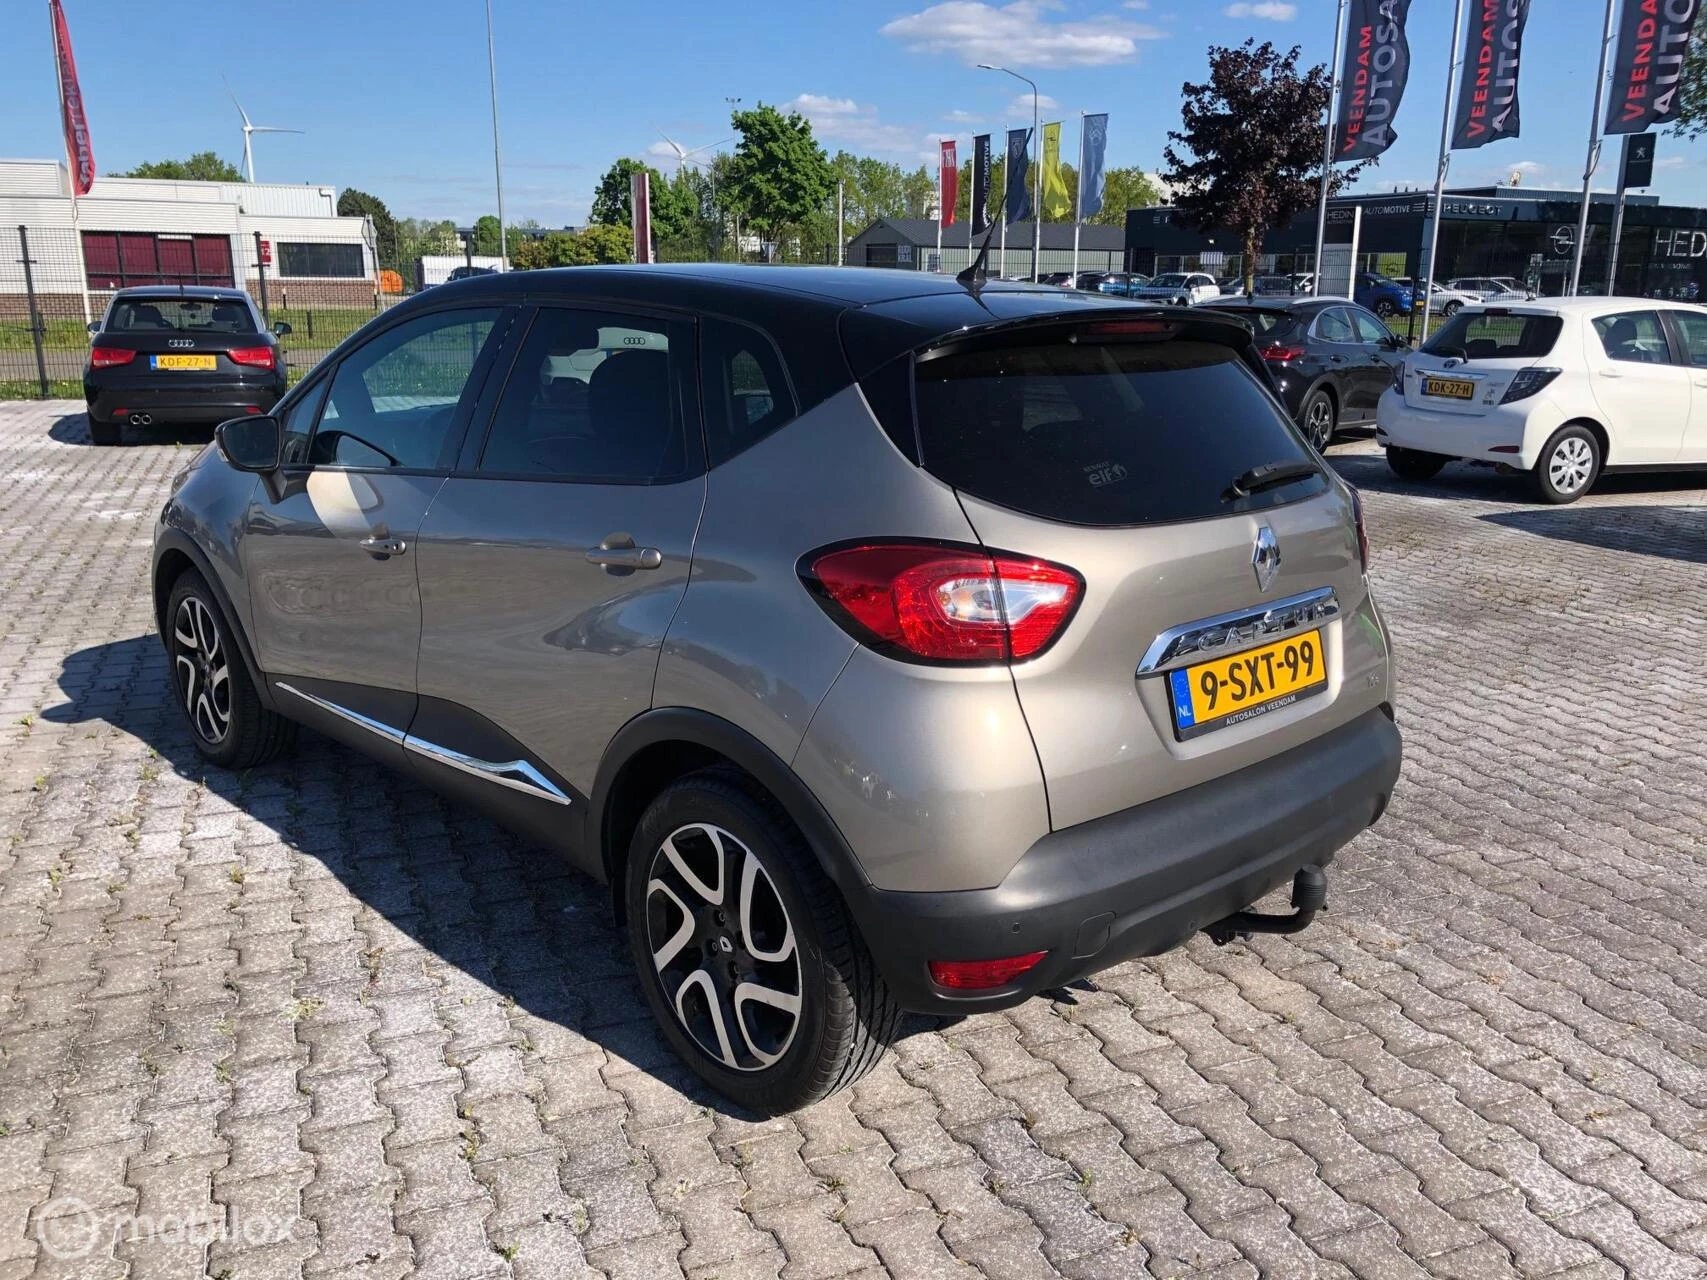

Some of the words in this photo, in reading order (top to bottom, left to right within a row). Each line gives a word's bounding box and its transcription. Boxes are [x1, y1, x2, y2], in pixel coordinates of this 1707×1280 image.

[1467, 0, 1500, 138] VEENDAM
[1343, 25, 1372, 152] VEENDAM
[1327, 211, 1354, 219] HEDIN
[1364, 205, 1411, 215] AUTOMOTIVE
[1443, 203, 1503, 215] PEUGEOT
[1428, 381, 1470, 396] KDK-27-H
[1089, 468, 1112, 485] elf
[1198, 604, 1326, 652] CAPTUR
[1200, 640, 1314, 711] 9-SXT-99
[1178, 705, 1191, 718] NL
[1226, 706, 1267, 726] AUTOSALON
[1267, 694, 1297, 711] VEENDAM
